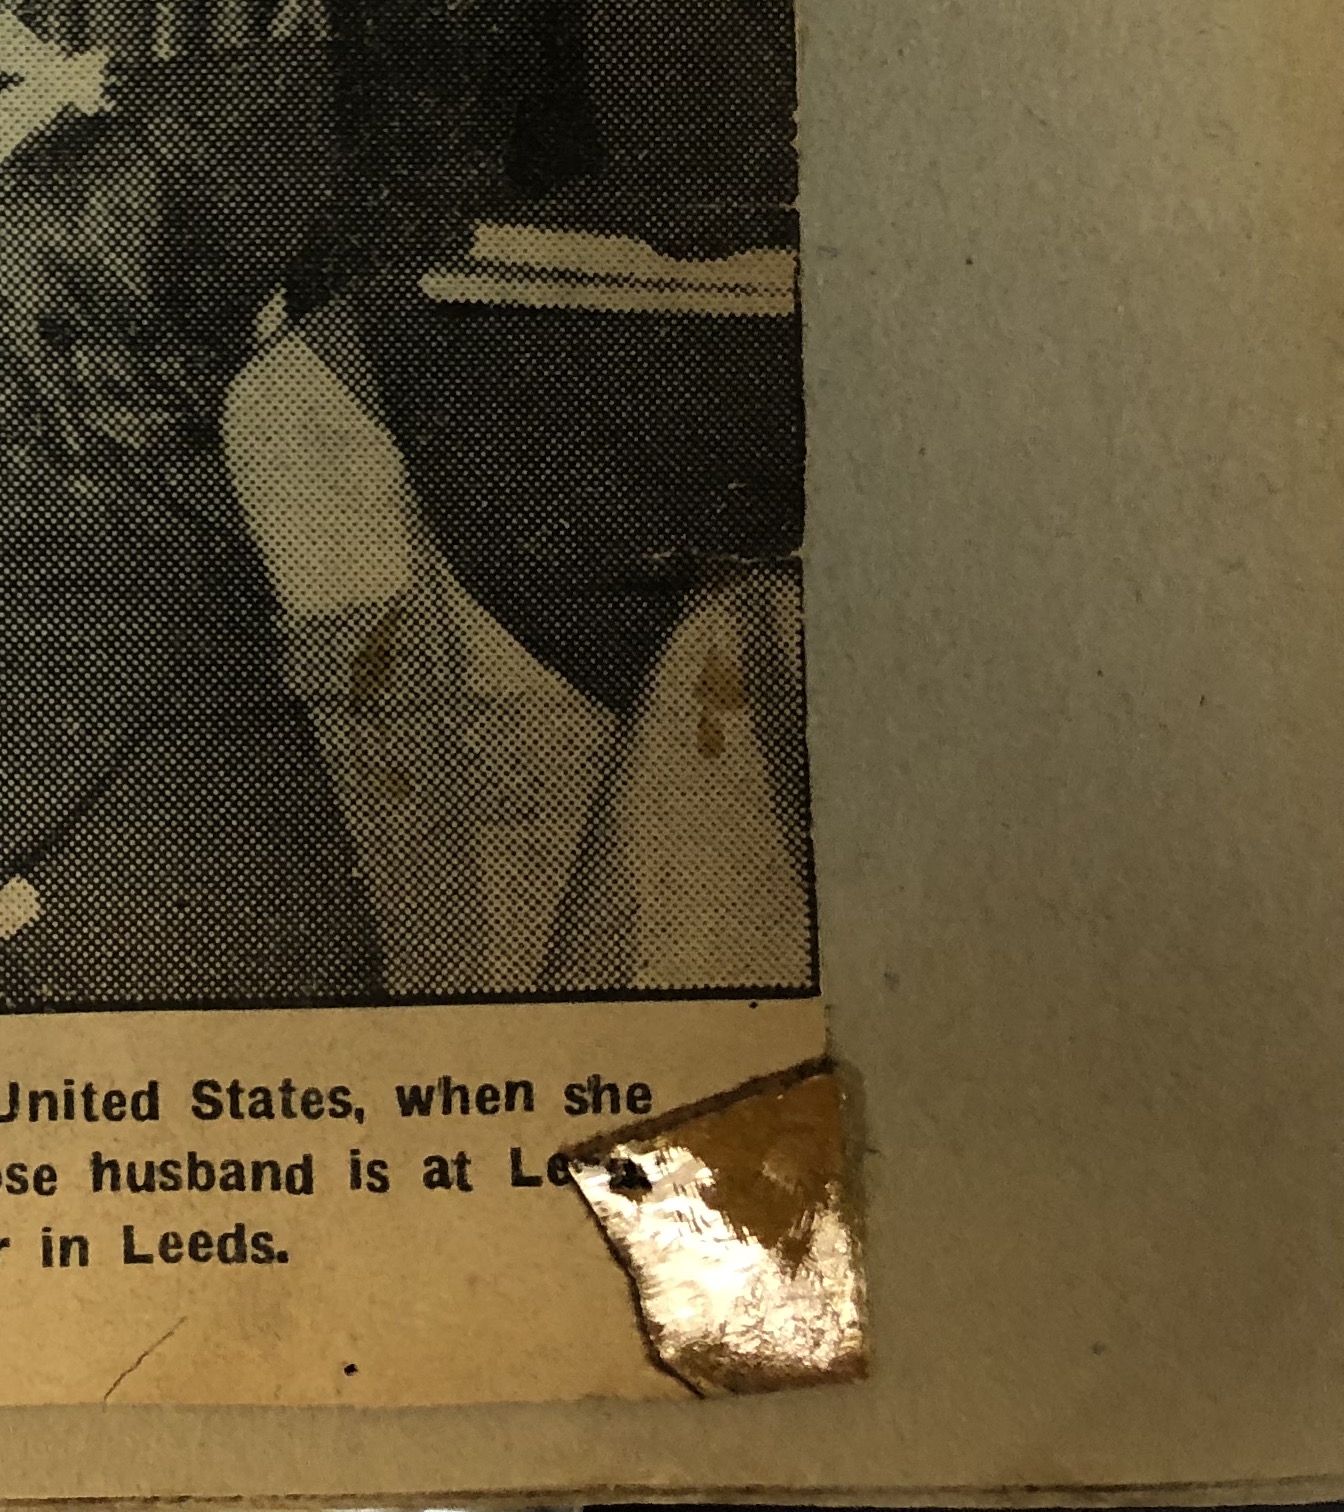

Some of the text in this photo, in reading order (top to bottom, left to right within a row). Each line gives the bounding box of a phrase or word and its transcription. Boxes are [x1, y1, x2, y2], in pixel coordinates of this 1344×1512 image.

[191, 1077, 365, 1125] States,
[394, 1074, 535, 1118] when
[563, 1073, 653, 1117] she
[89, 1150, 314, 1196] husband
[349, 1148, 391, 1194] is
[422, 1150, 474, 1193] at
[41, 1226, 90, 1269] in
[122, 1222, 290, 1266] Leeds.
